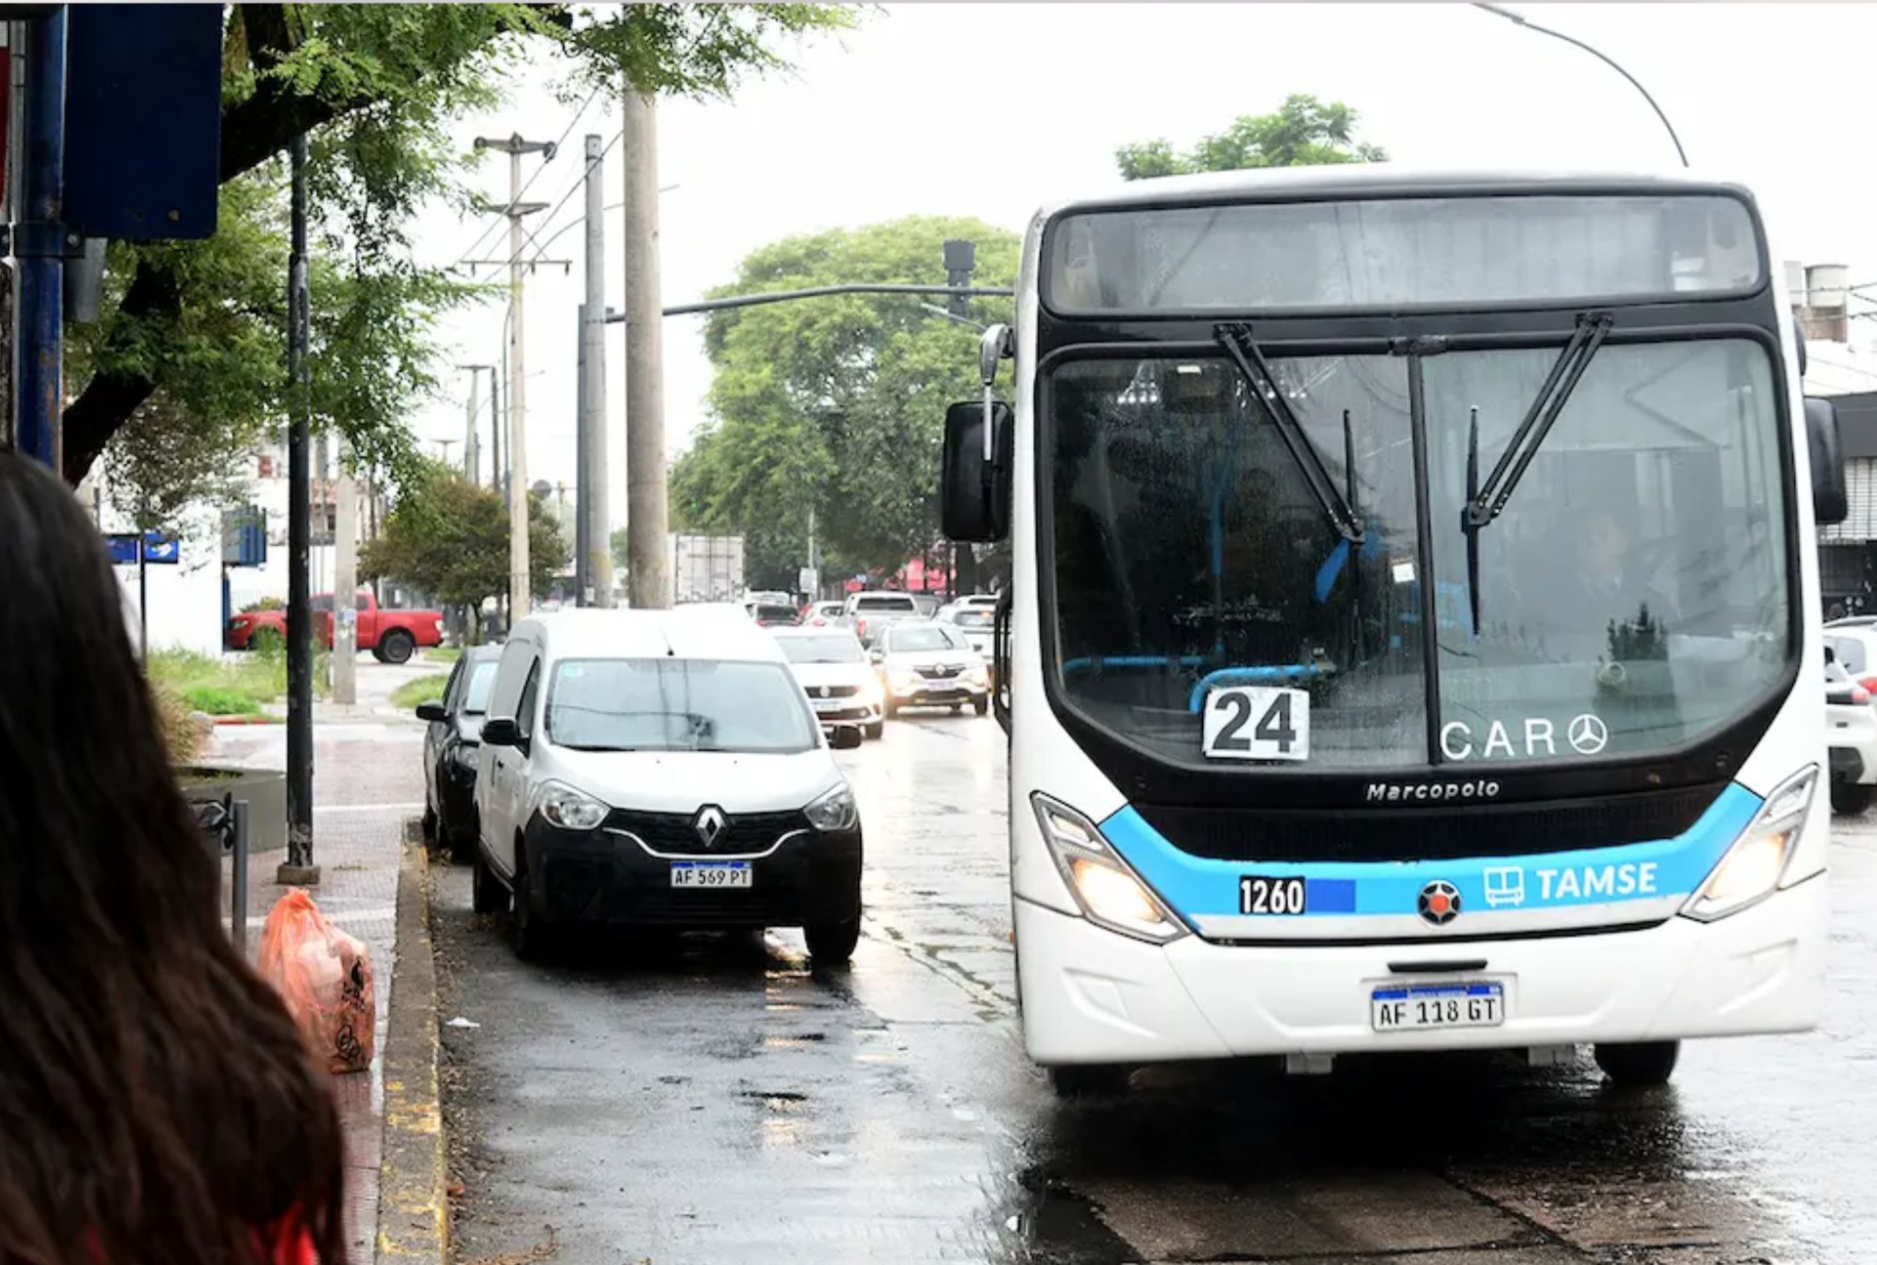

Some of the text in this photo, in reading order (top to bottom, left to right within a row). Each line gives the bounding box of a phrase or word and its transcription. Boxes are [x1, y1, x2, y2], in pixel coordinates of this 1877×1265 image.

[1212, 691, 1297, 753] 24
[1440, 718, 1556, 760] CAR
[1367, 780, 1500, 800] Marcopolo
[675, 869, 748, 885] AF 569 PT
[1536, 862, 1658, 900] TAMSE
[1241, 879, 1304, 914] 1260
[1381, 998, 1496, 1025] AF 118 GT
